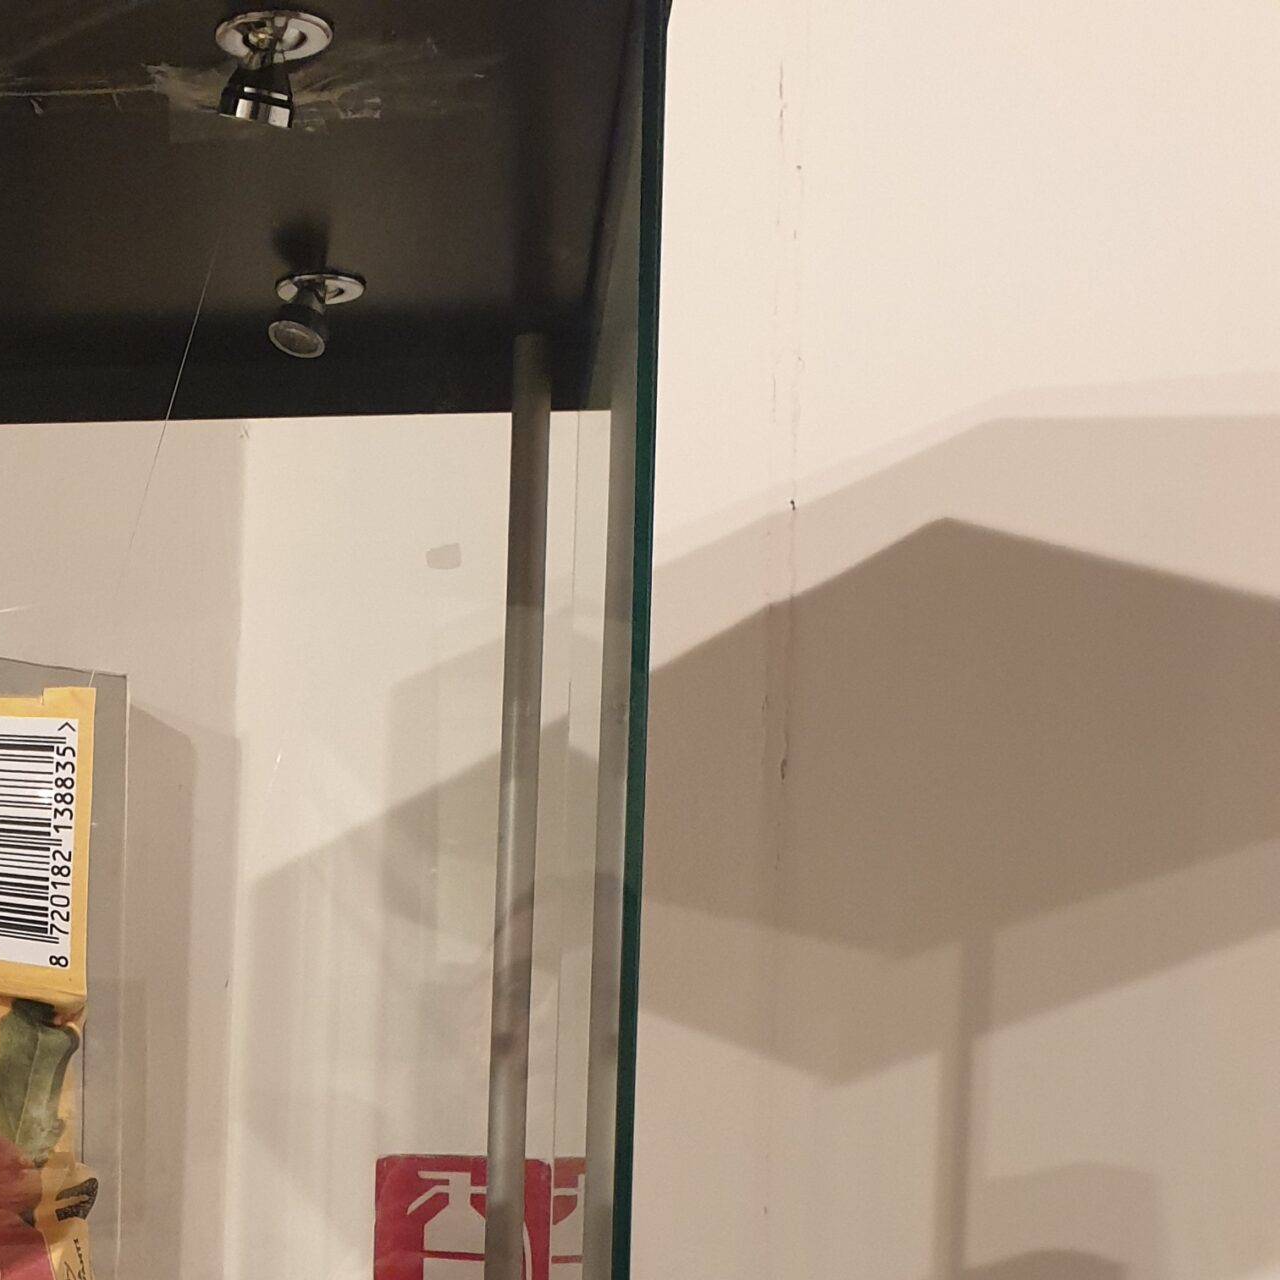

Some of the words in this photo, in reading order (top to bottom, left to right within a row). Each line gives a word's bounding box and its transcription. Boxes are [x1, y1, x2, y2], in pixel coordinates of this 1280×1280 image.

[52, 744, 77, 832] 138835
[49, 847, 72, 935] 720182
[48, 953, 69, 968] 8
